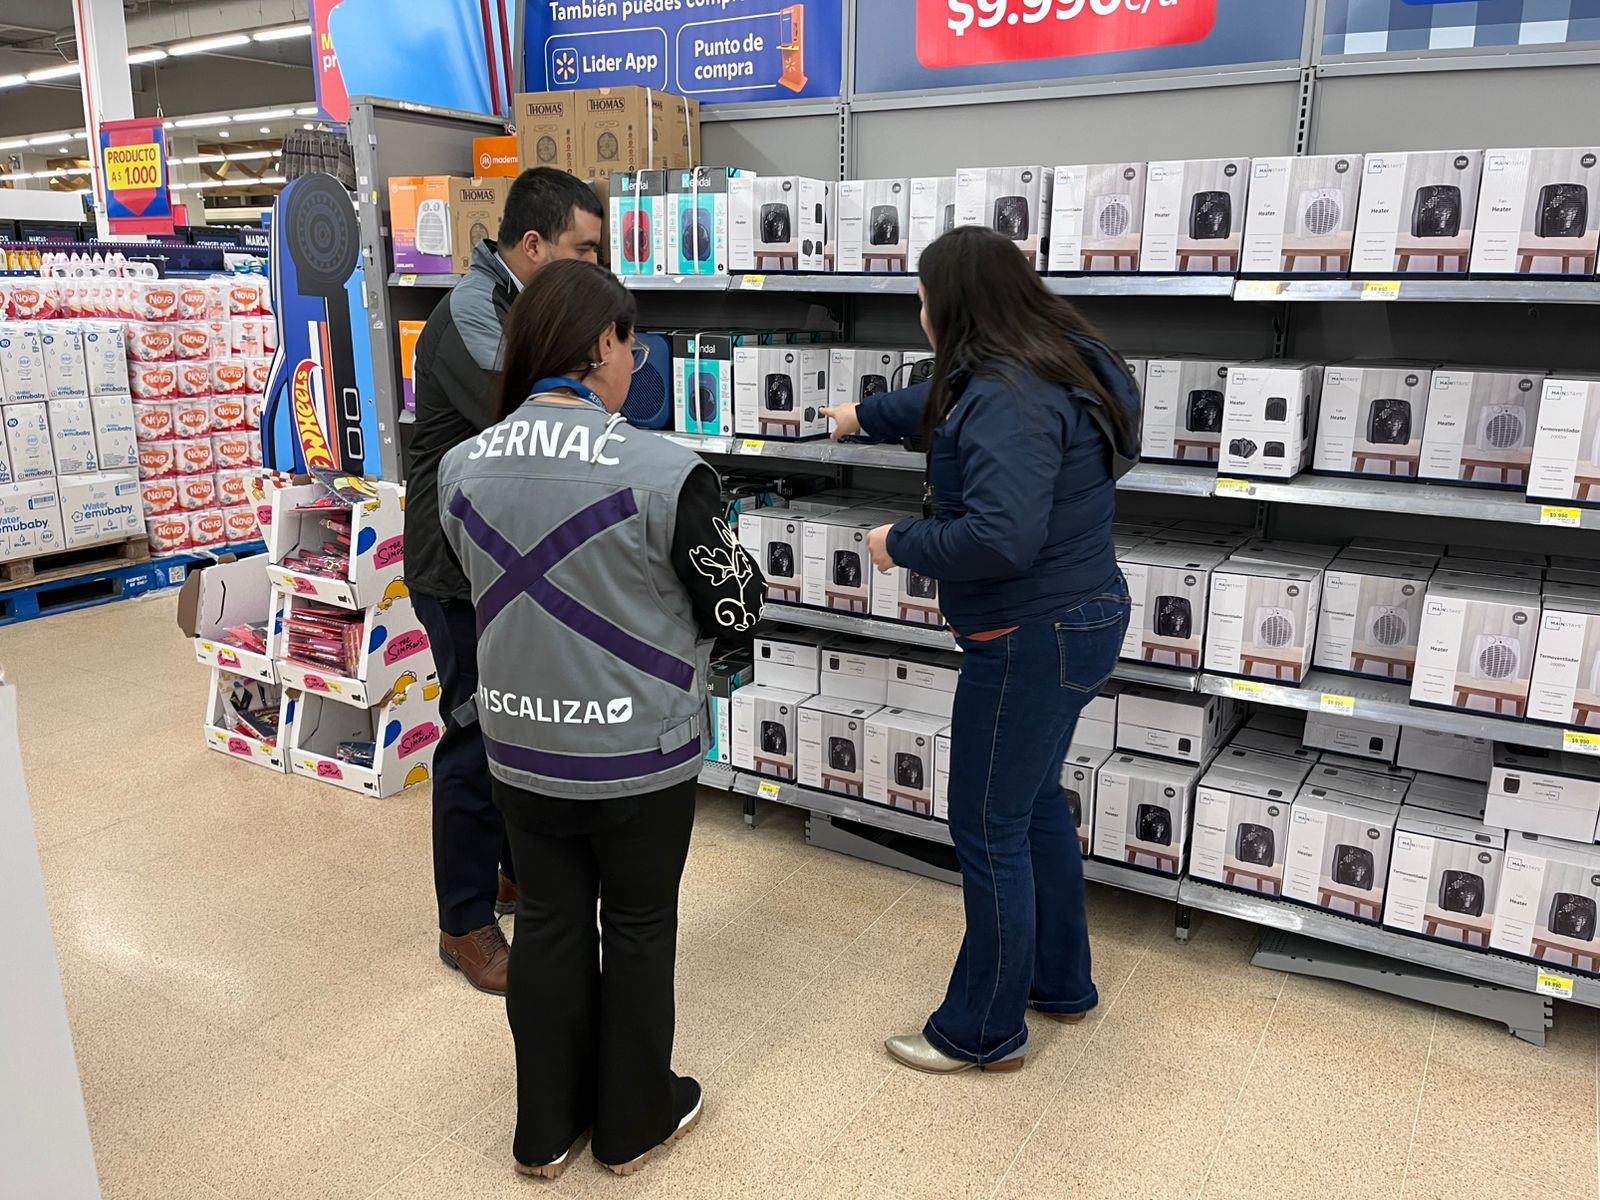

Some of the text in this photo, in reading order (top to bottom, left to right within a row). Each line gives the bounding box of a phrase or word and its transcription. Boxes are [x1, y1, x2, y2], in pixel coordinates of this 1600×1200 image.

[694, 33, 764, 58] Punto de
[582, 52, 658, 73] Lider App
[694, 60, 754, 80] compra
[527, 102, 562, 115] THOMAS
[589, 98, 624, 111] THOMAS
[107, 148, 157, 164] PRODUCTO
[461, 189, 494, 201] THOMAS
[1540, 426, 1580, 434] Termoventilador
[468, 420, 627, 466] SERNAC
[82, 501, 109, 511] Water
[85, 504, 133, 520] emubaby
[1430, 646, 1448, 654] Heater
[1510, 898, 1528, 907] Heater
